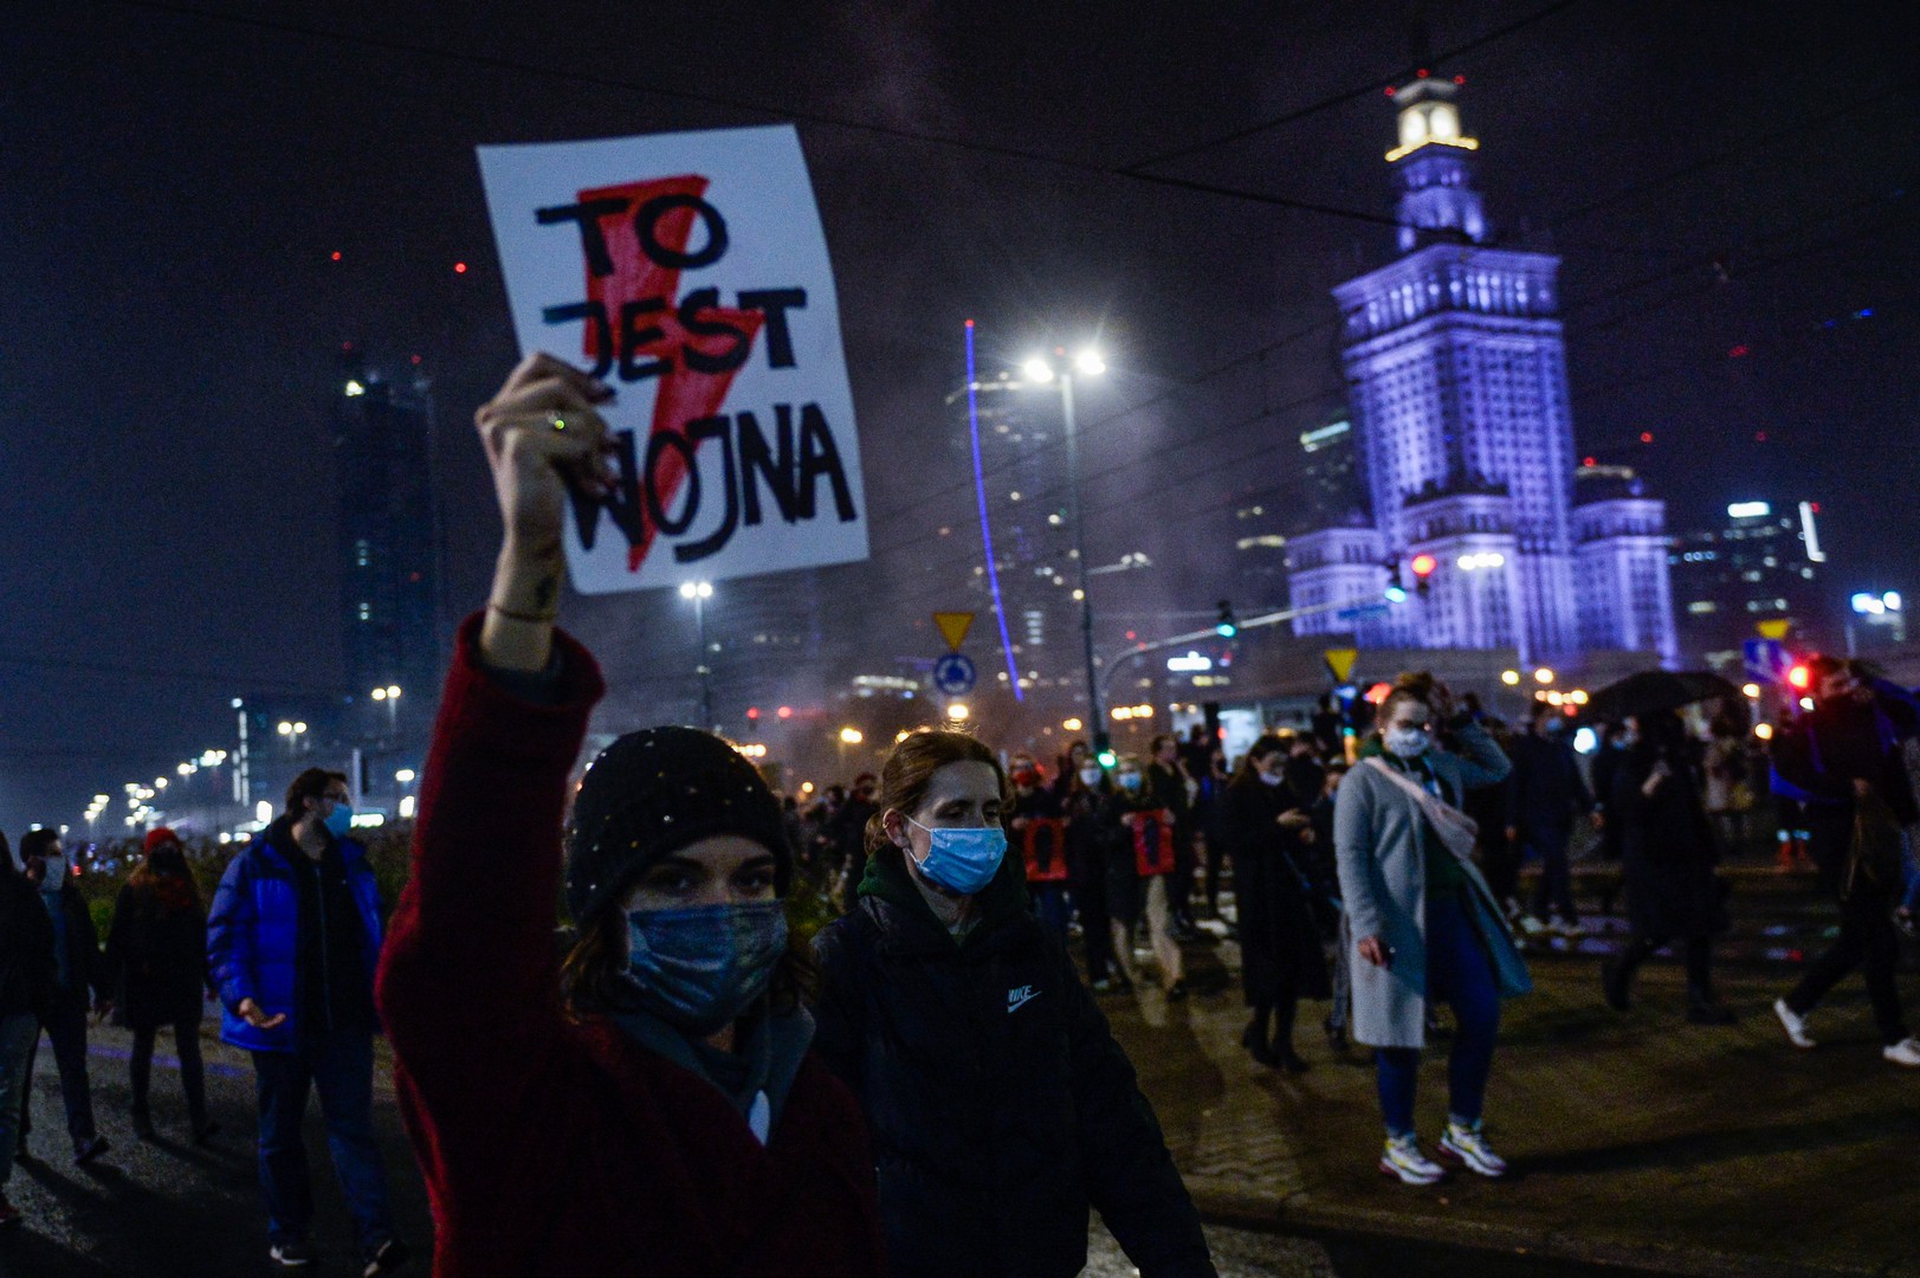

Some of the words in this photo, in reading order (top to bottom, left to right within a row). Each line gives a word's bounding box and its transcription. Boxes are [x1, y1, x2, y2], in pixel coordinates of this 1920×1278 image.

[535, 193, 728, 275] TO
[543, 287, 806, 381] JEST
[556, 402, 856, 563] WOJNA
[1008, 984, 1033, 1003] NIKE
